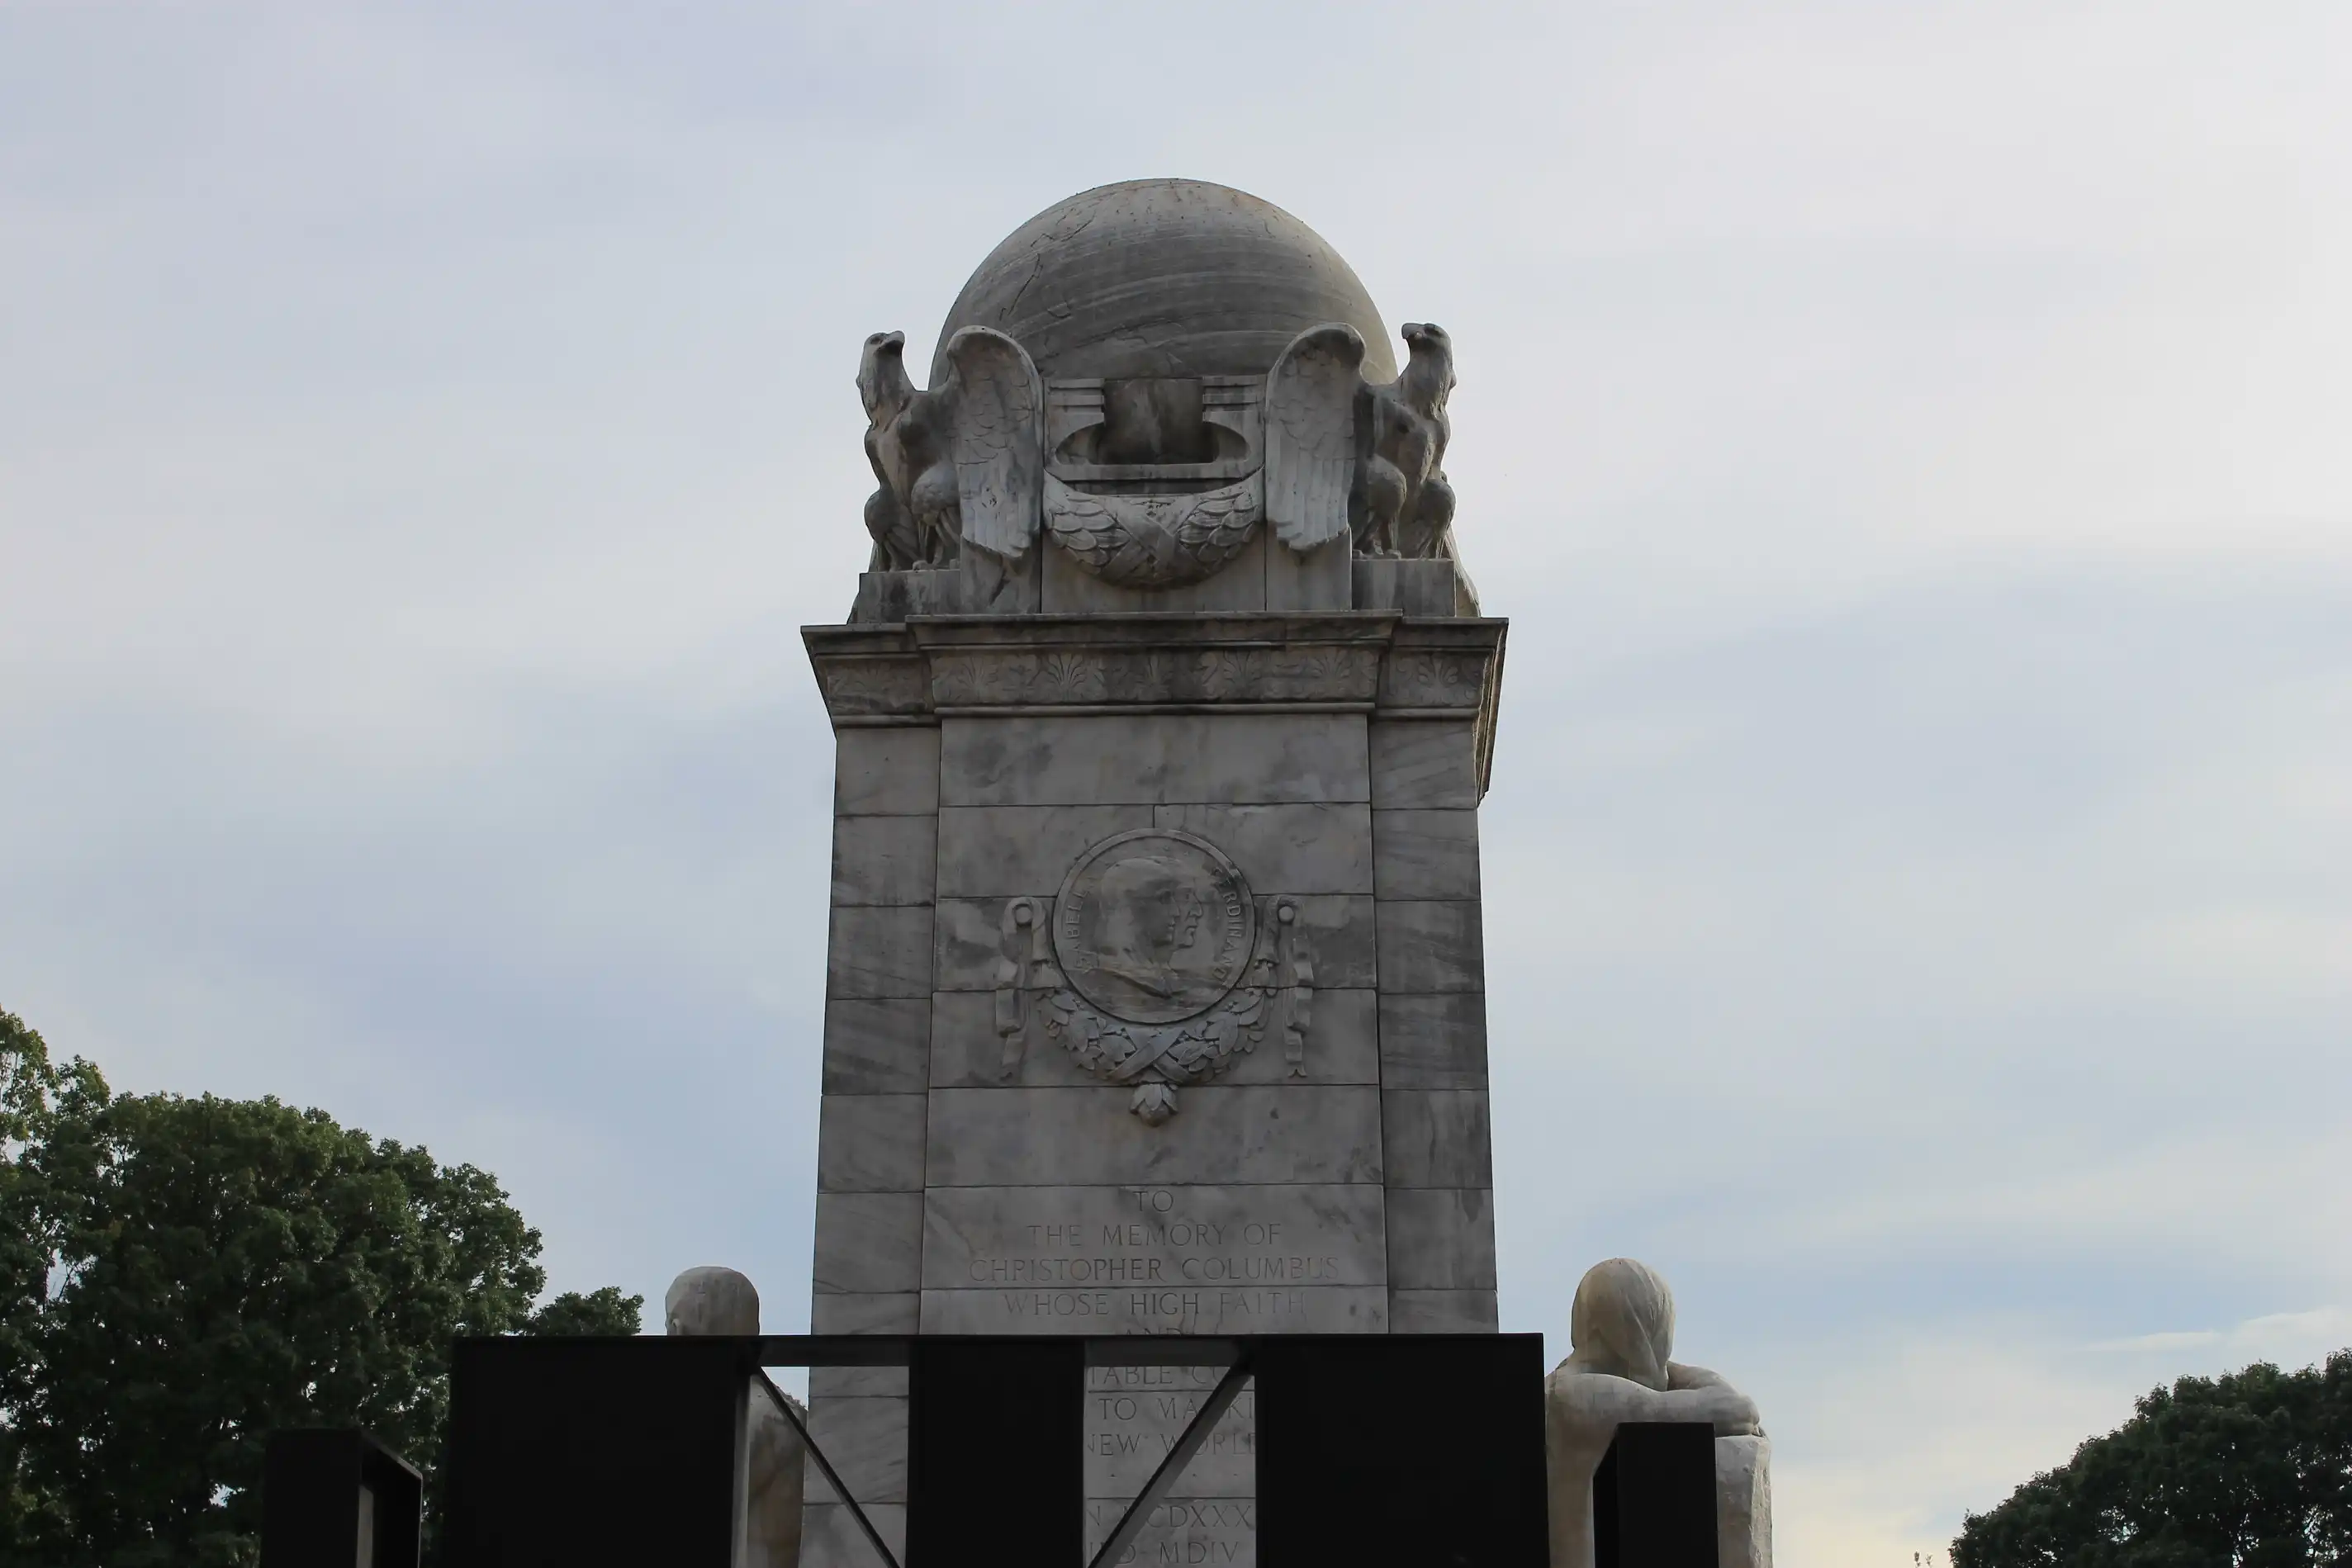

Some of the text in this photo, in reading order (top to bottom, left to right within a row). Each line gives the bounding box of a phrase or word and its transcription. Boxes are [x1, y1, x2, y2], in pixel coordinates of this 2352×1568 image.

[1132, 1190, 1174, 1212] TO
[1027, 1223, 1281, 1247] THE MEMORY OF
[969, 1257, 1340, 1283] CHRISTOPHER COLUMBUS
[1004, 1292, 1306, 1316] WHOSE HIGH FAITH
[1098, 1396, 1253, 1420] TO MAKI
[1124, 1505, 1252, 1528] CDXXX
[1160, 1541, 1239, 1565] MDIV
